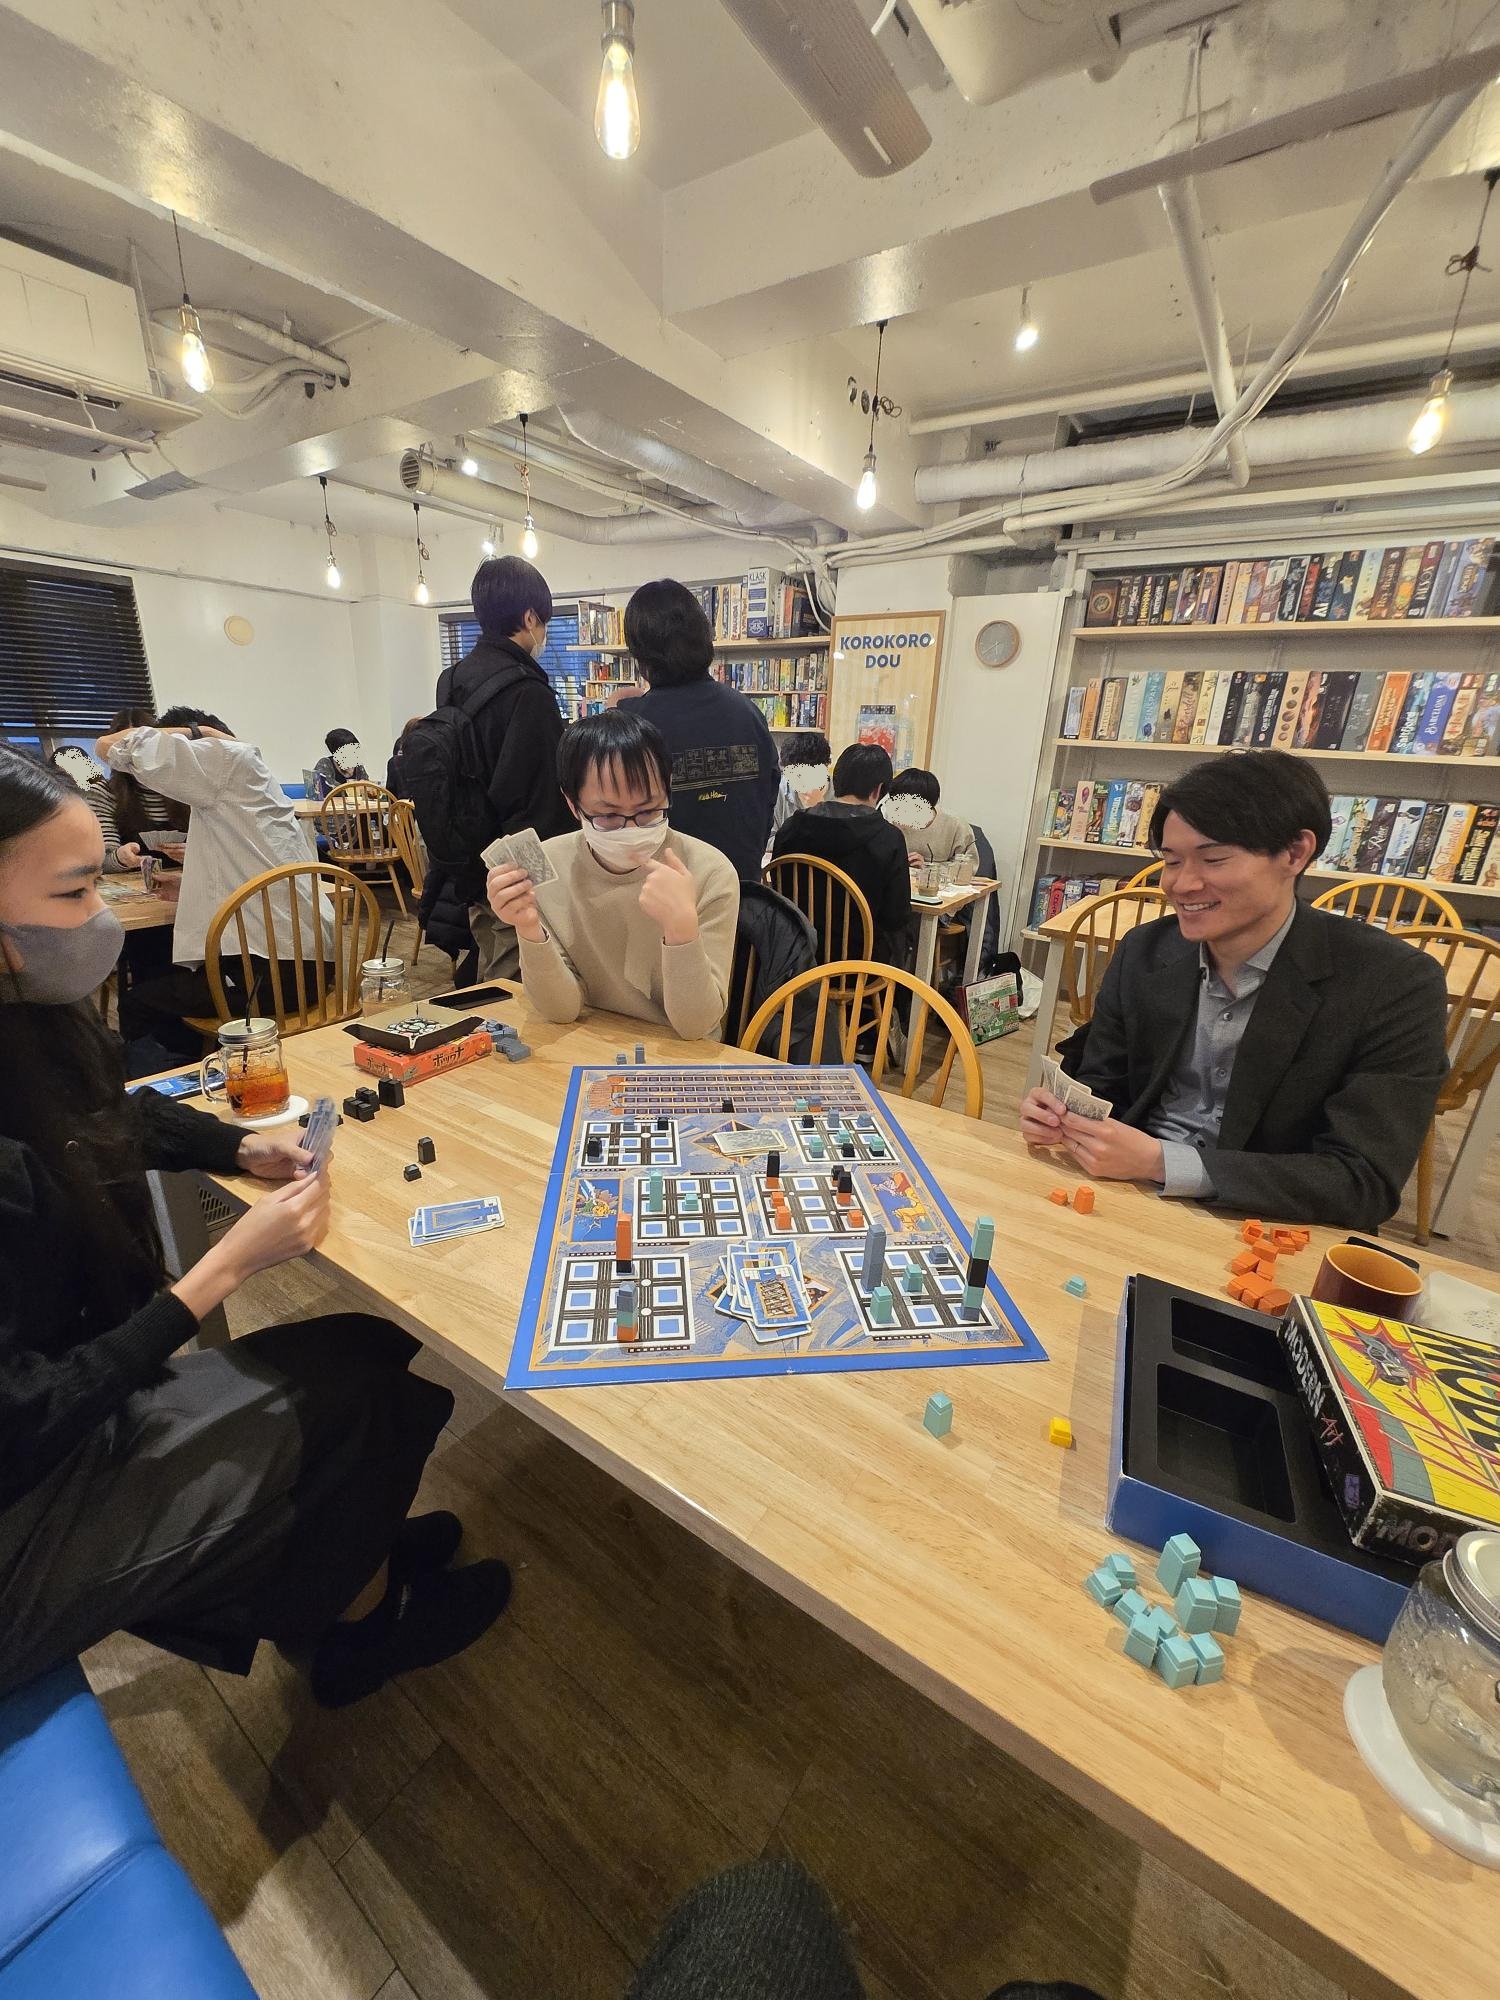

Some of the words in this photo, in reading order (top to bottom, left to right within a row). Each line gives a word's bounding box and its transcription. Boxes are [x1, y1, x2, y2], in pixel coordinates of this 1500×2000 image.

[749, 571, 766, 582] KLASK
[840, 632, 932, 651] KOROKORO
[865, 654, 901, 669] DOU
[1283, 1317, 1326, 1419] MODERN
